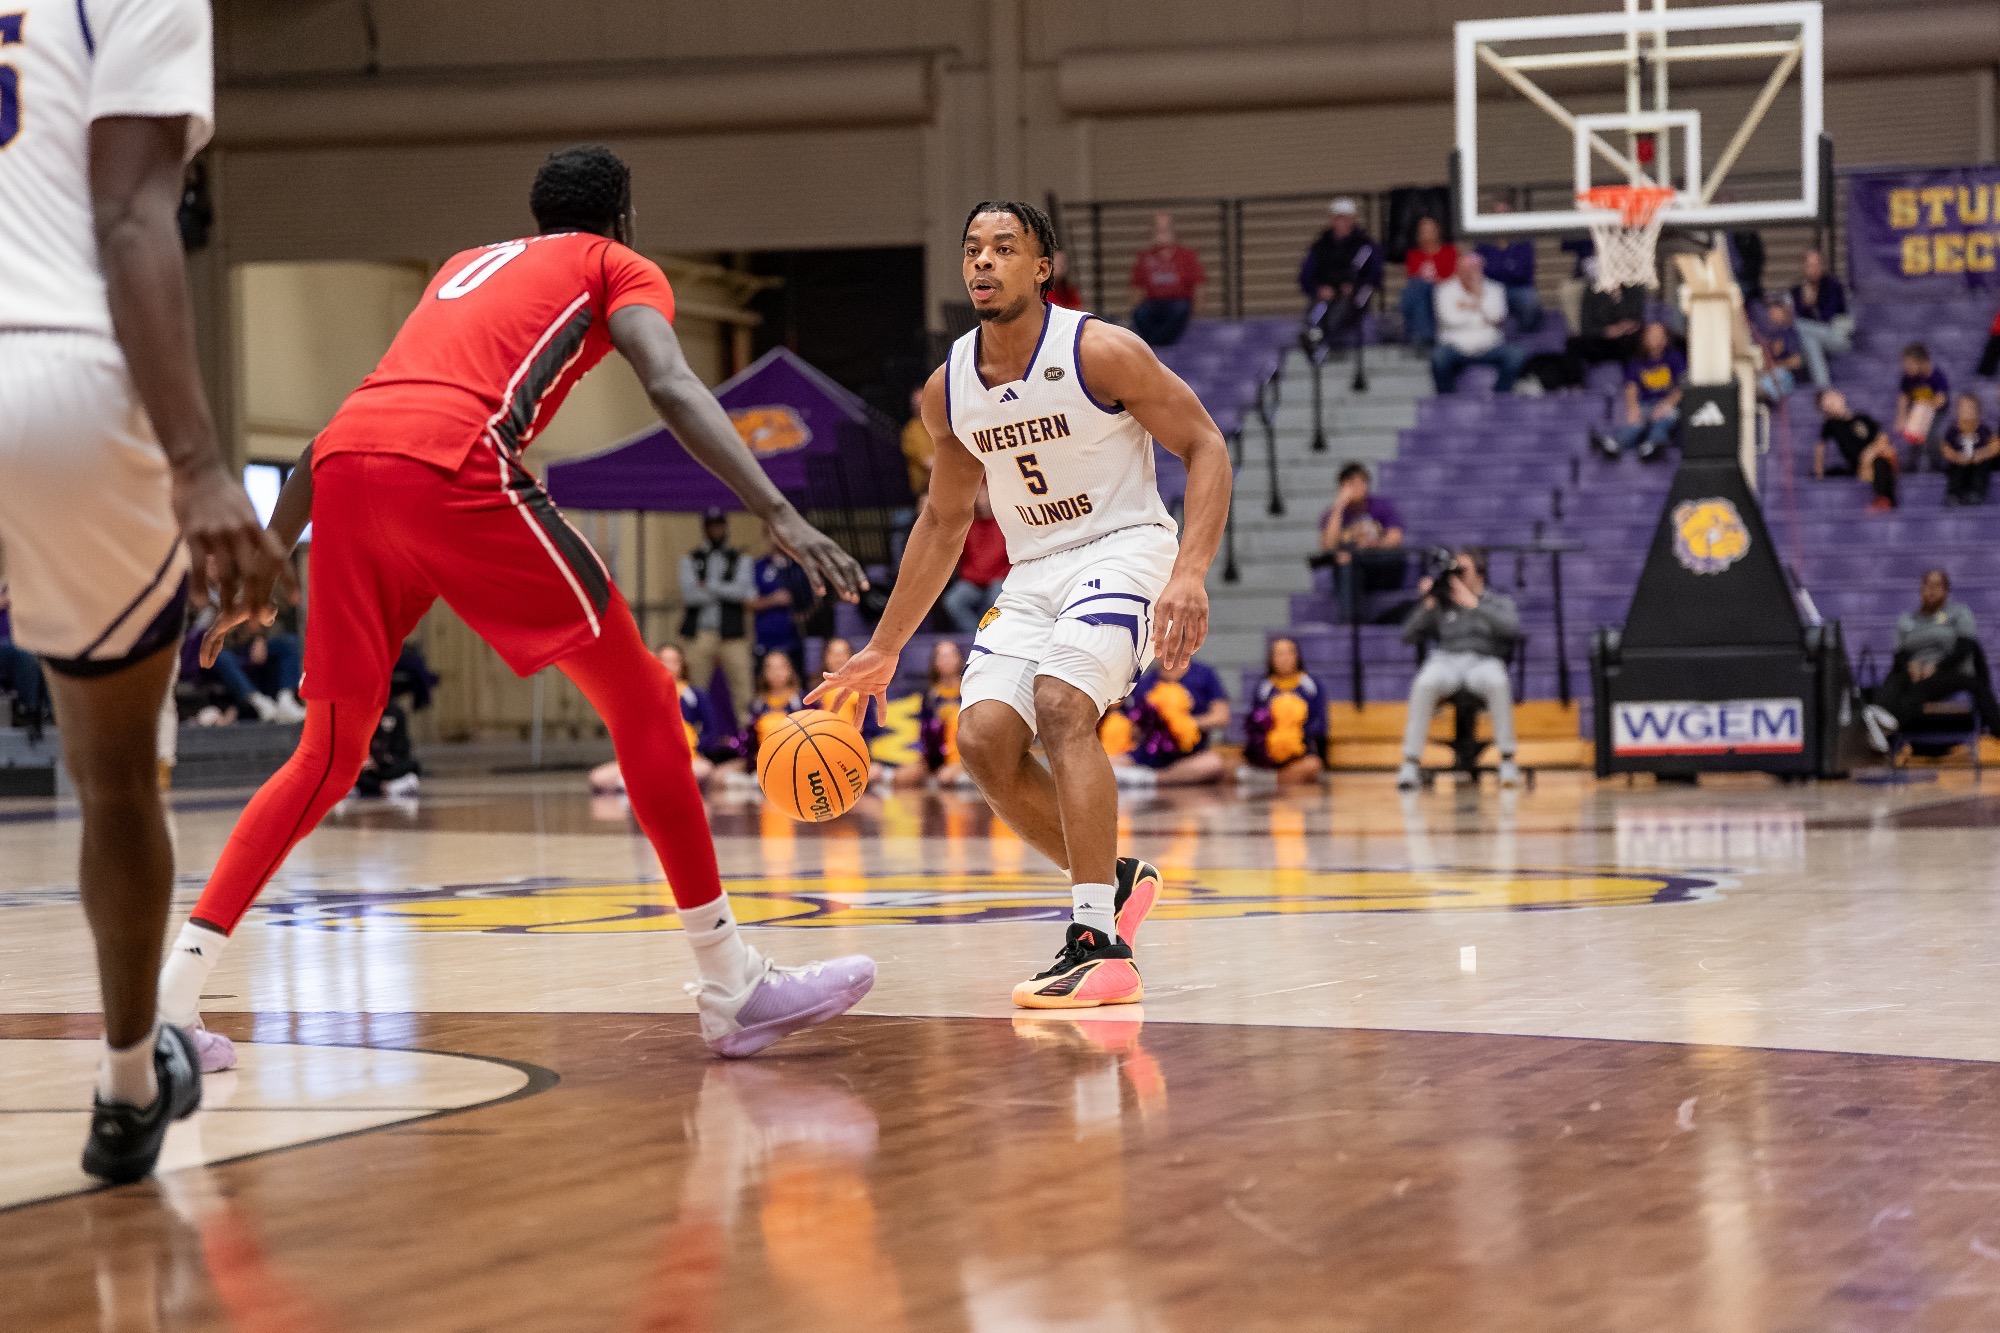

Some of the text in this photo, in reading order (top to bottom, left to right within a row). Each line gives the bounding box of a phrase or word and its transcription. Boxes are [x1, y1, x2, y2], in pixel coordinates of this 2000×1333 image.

[436, 243, 528, 300] 0
[1901, 232, 2000, 275] SEC
[972, 413, 1071, 454] WESTERN
[1014, 452, 1049, 496] 5
[1014, 491, 1093, 526] ILLINOIS
[1622, 706, 1798, 740] WGEM
